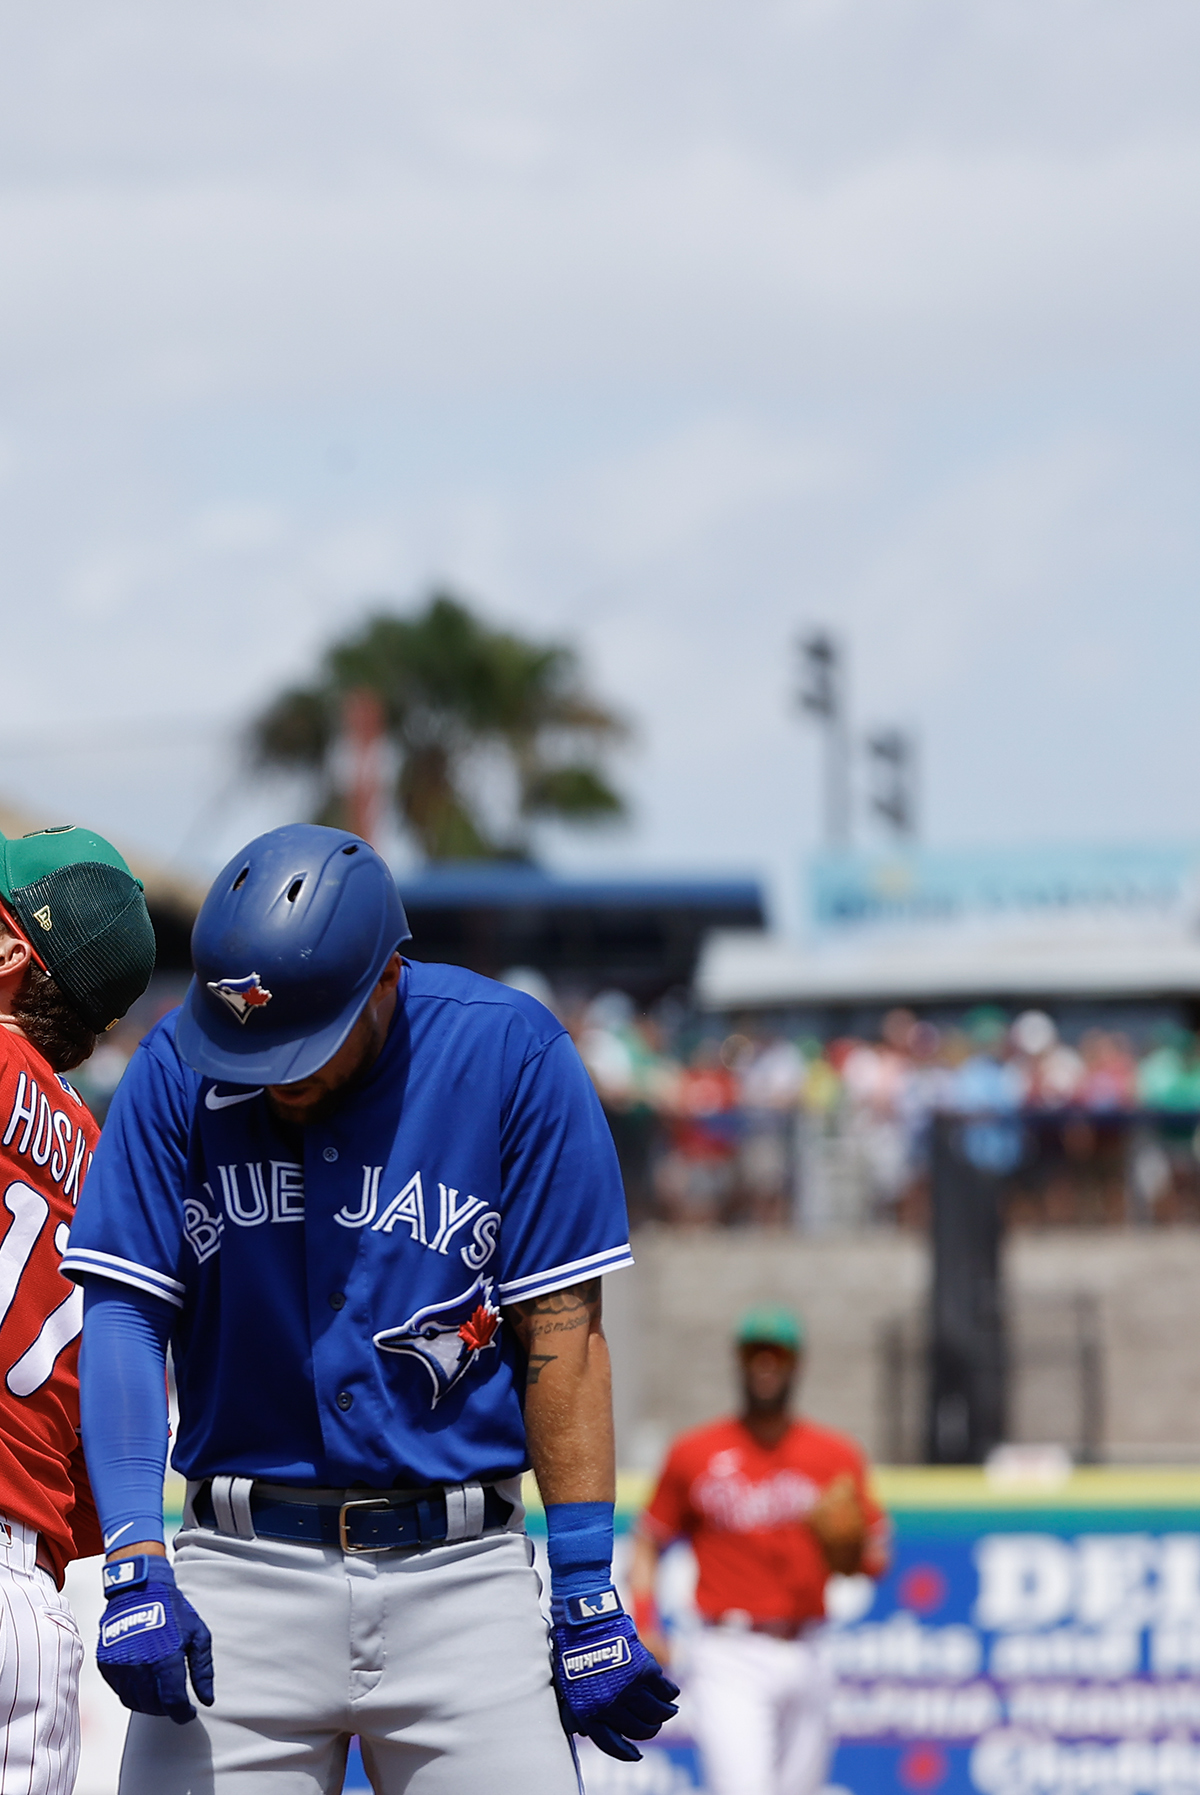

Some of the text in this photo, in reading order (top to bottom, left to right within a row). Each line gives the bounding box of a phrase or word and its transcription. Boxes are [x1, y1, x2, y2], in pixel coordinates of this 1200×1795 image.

[333, 1165, 502, 1270] JAYS
[104, 1604, 161, 1639] Franklin
[566, 1639, 624, 1673] Franklin
